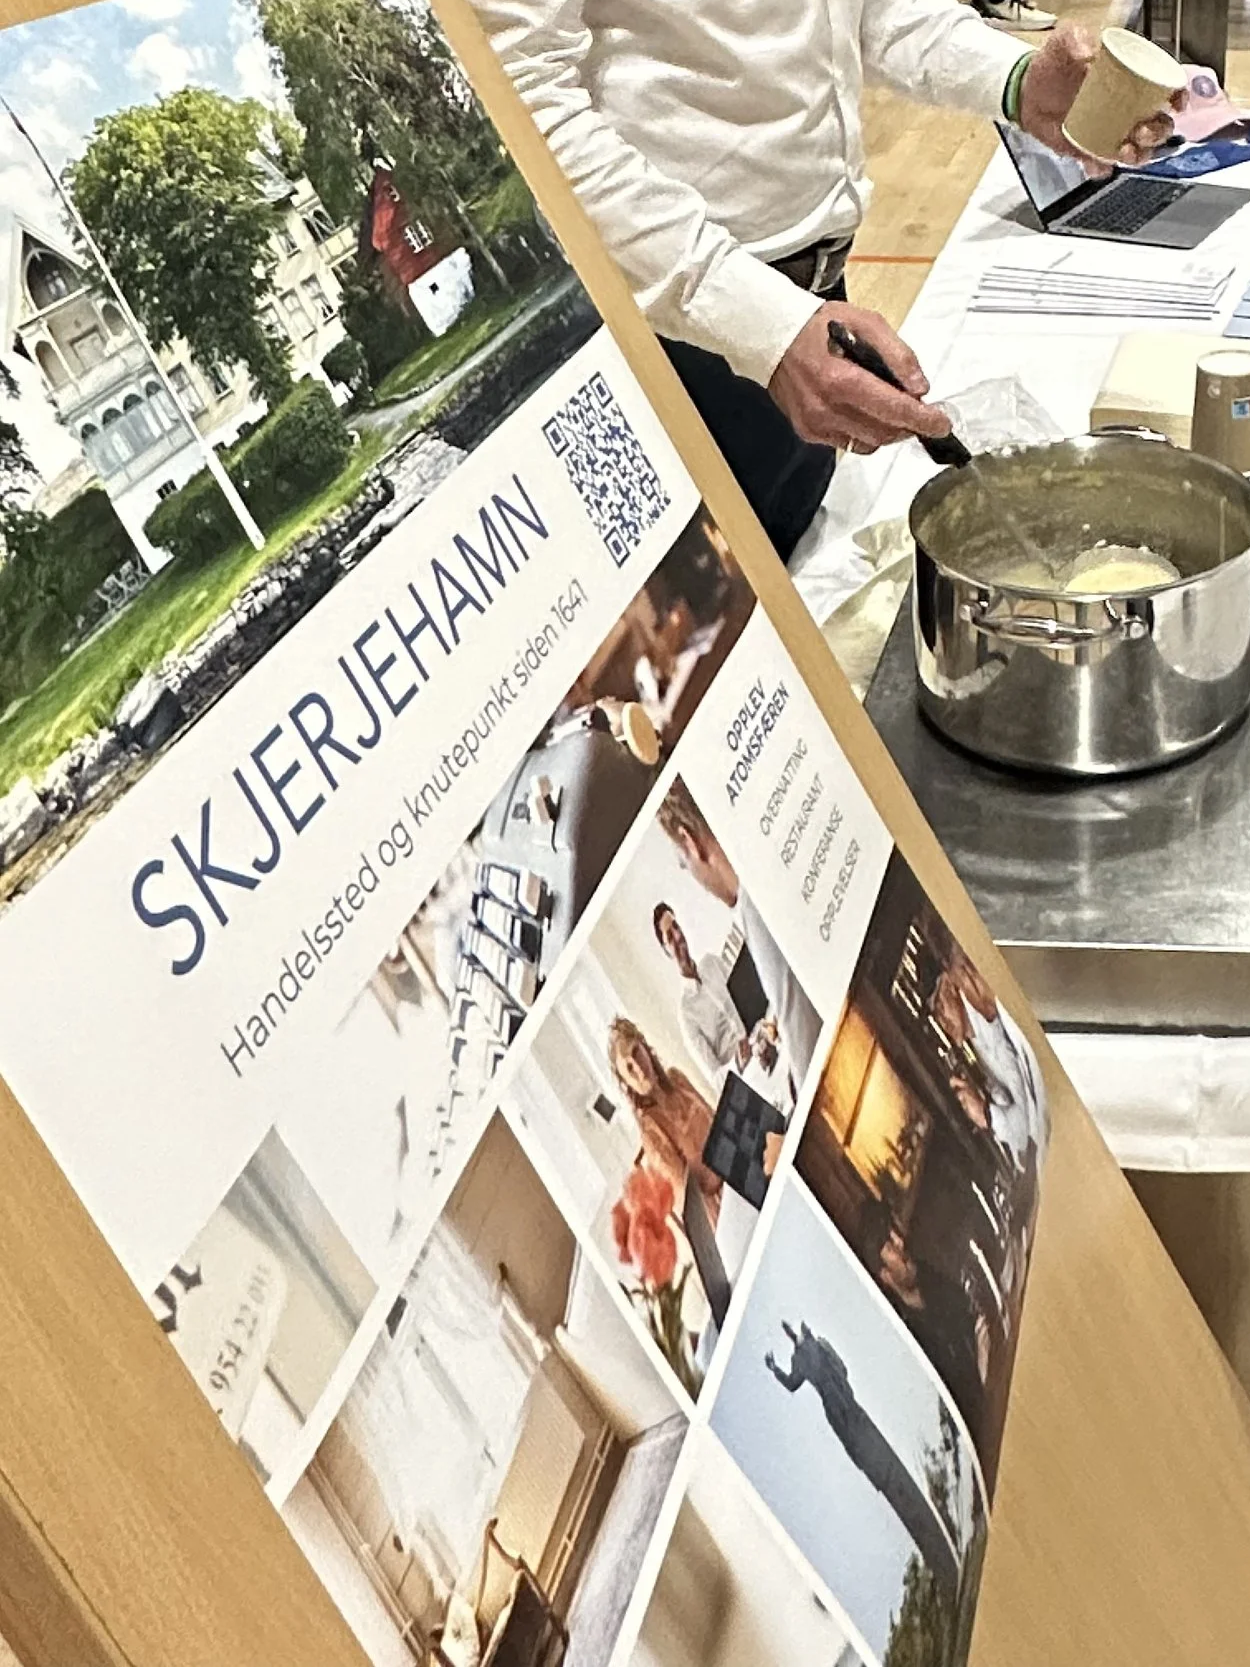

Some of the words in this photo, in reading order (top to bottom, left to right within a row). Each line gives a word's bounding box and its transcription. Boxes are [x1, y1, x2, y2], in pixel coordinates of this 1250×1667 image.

[131, 473, 551, 977] SKJERJEHAMN
[726, 676, 766, 752] OPPLEV
[219, 856, 381, 1078] Handelssted
[378, 824, 412, 866] og
[402, 675, 518, 829] knutepunkt
[512, 624, 560, 687] siden
[550, 578, 588, 630] 1641
[759, 737, 809, 836] OVERNATTING
[780, 772, 825, 869] RESTAURANT
[801, 802, 844, 905] KONFERANSE
[819, 838, 861, 942] OPPLEVELSER
